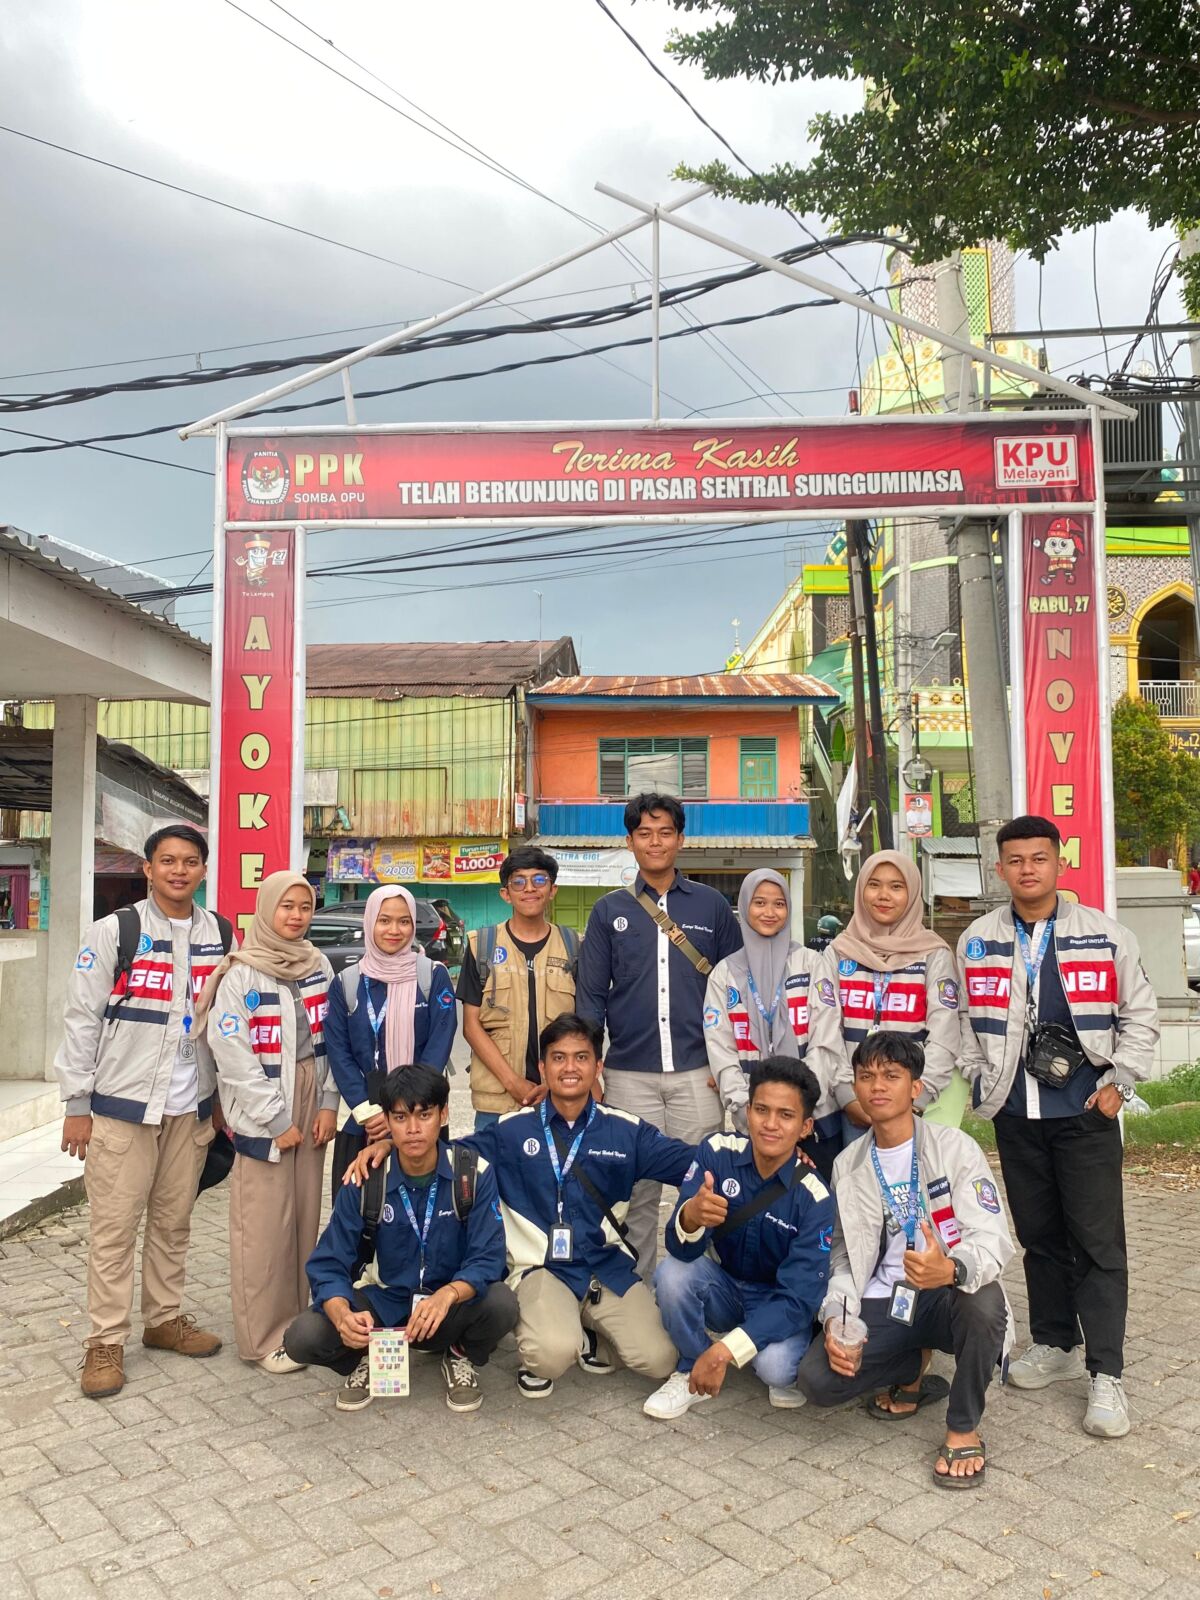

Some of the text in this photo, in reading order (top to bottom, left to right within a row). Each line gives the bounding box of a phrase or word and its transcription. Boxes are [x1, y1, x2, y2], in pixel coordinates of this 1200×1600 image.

[552, 437, 801, 474] Terima Kasih
[1002, 442, 1068, 467] KPU
[295, 453, 365, 486] PPK
[1003, 466, 1070, 482] Melayani
[294, 492, 365, 503] SOMBA OPU
[399, 469, 964, 504] TELAH BERKUNJUNG DI PASAR SENTRAL SUNGGUMINASA
[1029, 595, 1090, 615] RABU, 27
